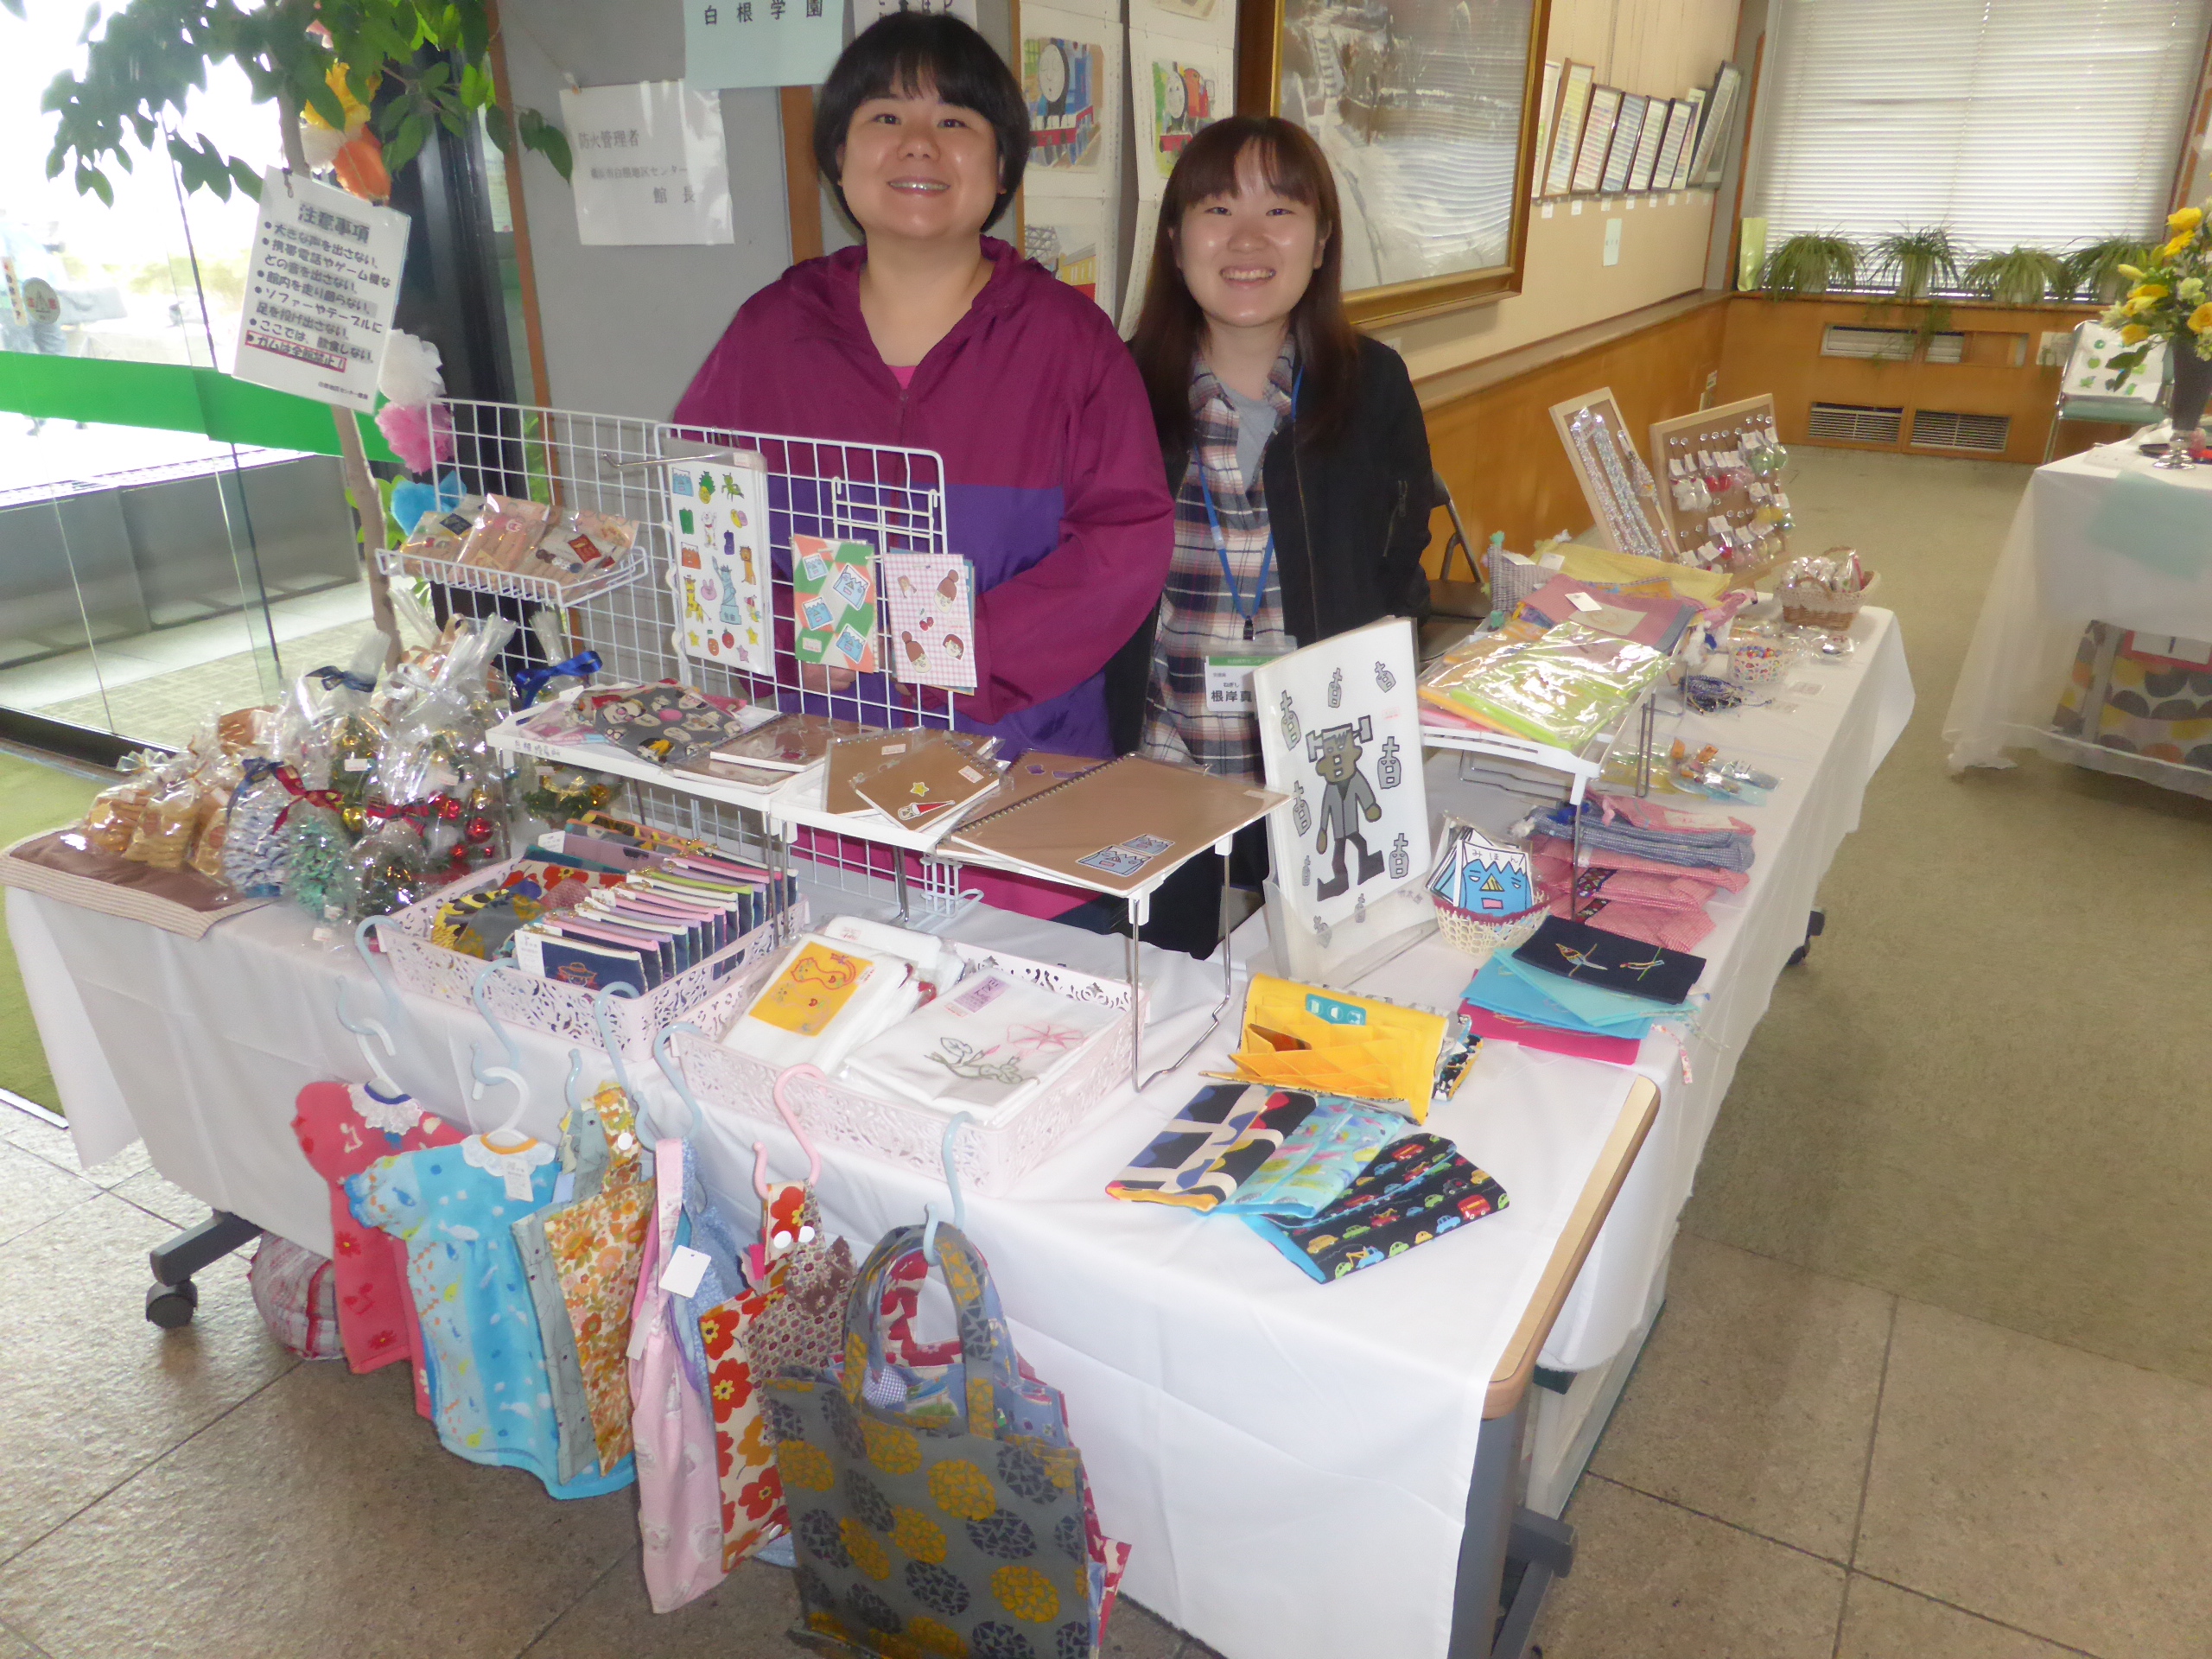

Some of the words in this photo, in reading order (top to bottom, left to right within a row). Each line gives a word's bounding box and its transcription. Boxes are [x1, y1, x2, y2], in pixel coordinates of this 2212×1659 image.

[703, 0, 823, 25] 白根学園
[578, 129, 639, 149] 防火管理者
[297, 204, 370, 244] 注意事項
[271, 238, 391, 288] 携帯電話やゲーム機な
[274, 224, 378, 269] 大きな声を出さない。
[265, 288, 383, 334] ソファーやテーブルに
